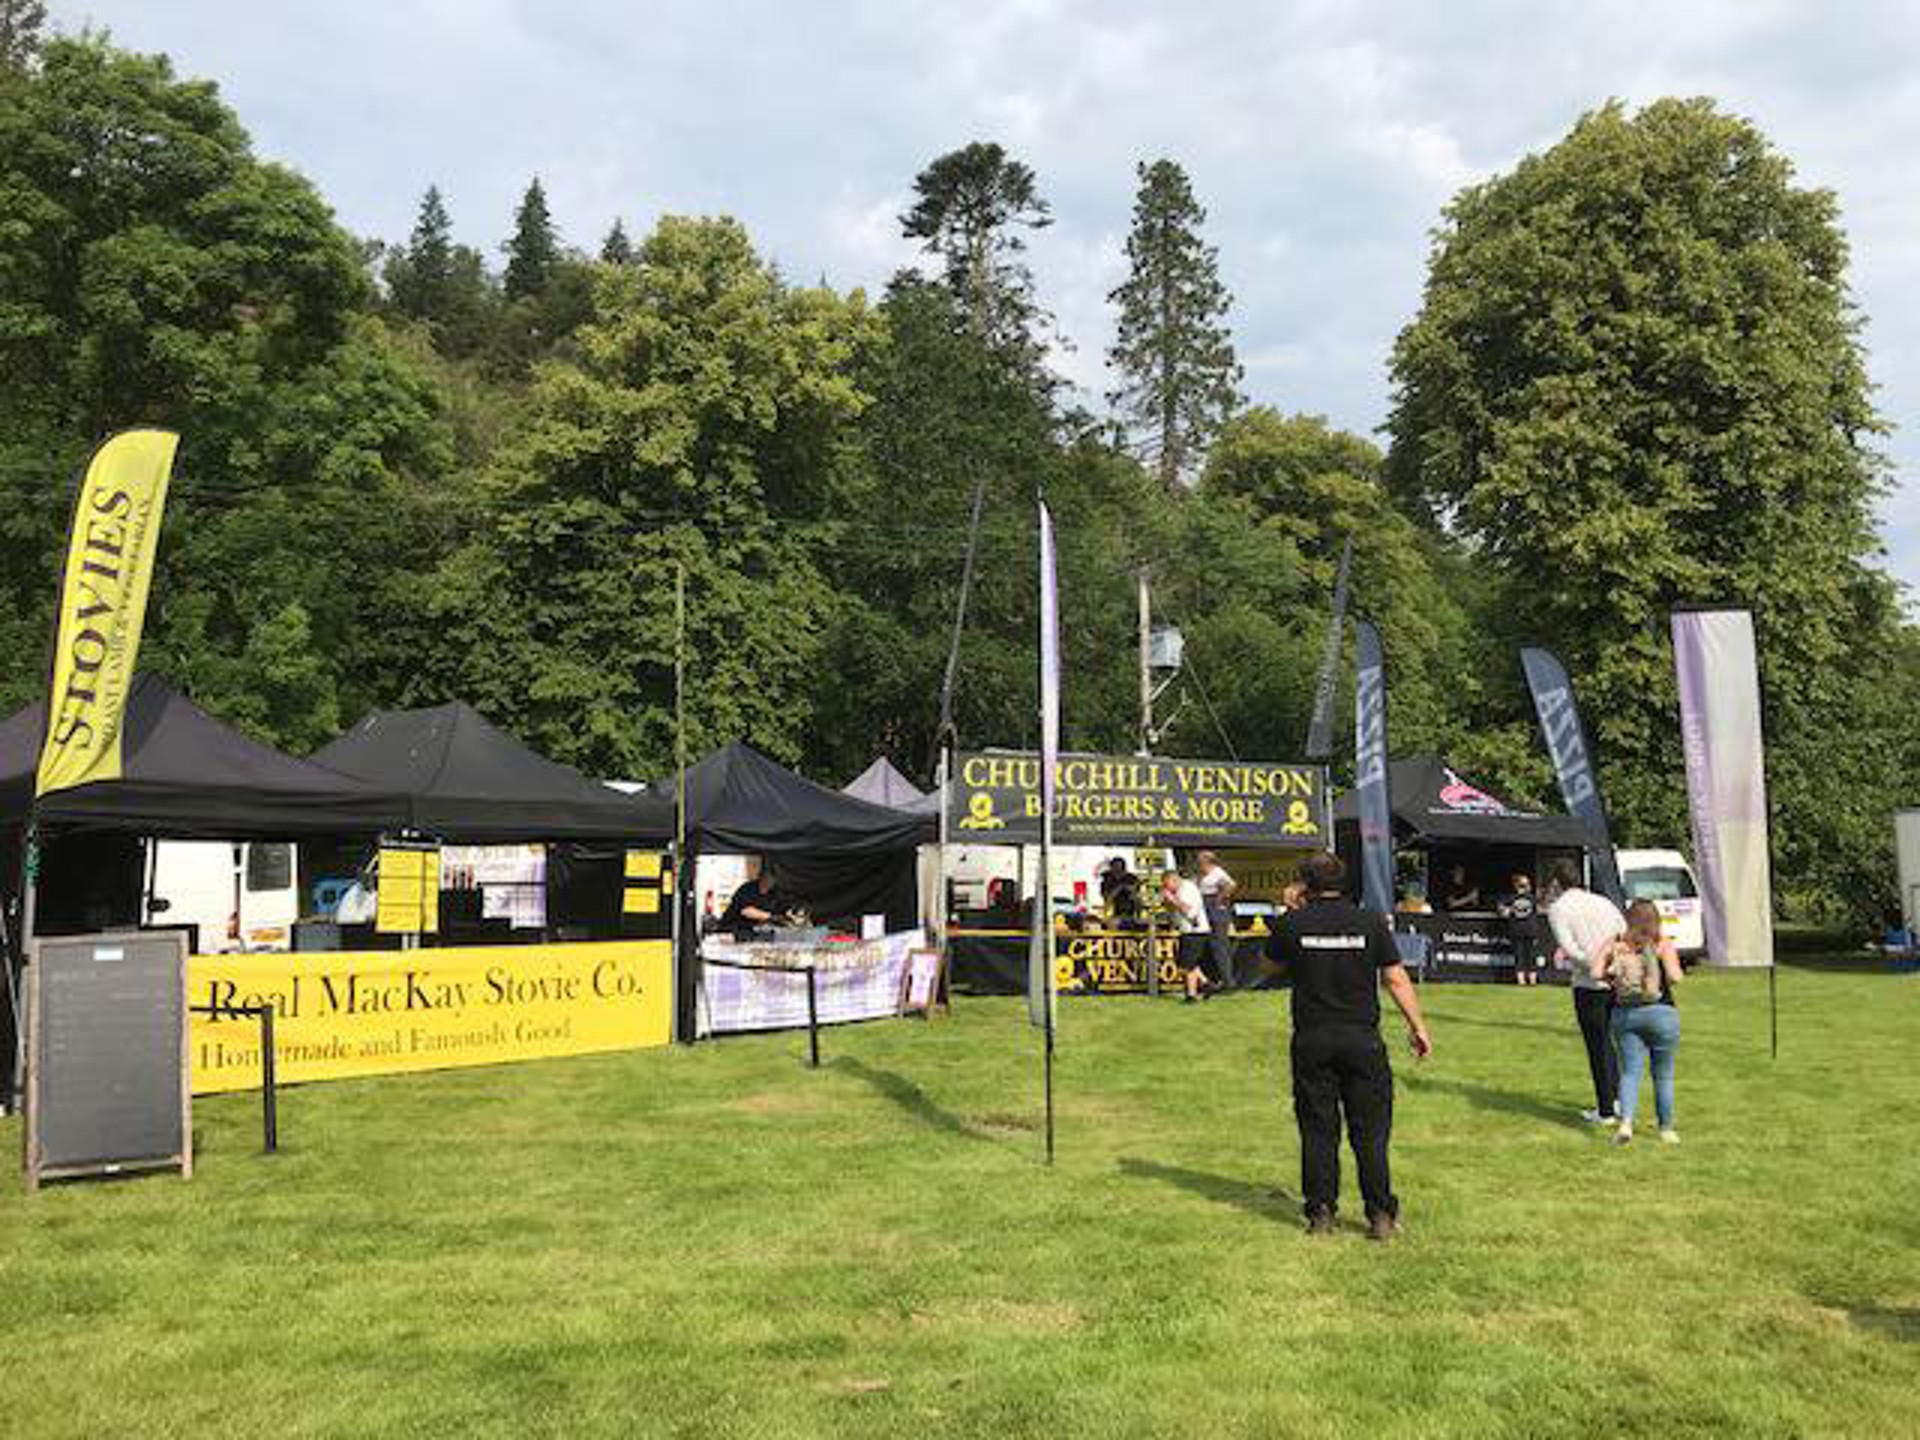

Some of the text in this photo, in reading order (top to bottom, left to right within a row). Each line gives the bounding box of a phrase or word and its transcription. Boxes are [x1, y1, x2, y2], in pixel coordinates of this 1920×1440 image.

[54, 486, 131, 749] STOVIES
[1176, 766, 1313, 797] VENISON
[1160, 797, 1182, 820] &
[1188, 797, 1265, 823] MORE
[208, 975, 299, 1023] Real
[318, 970, 473, 1018] MacKay
[483, 963, 581, 1005] Stovie
[592, 959, 644, 999] Co.
[359, 1029, 401, 1058] and
[515, 1016, 572, 1043] Good
